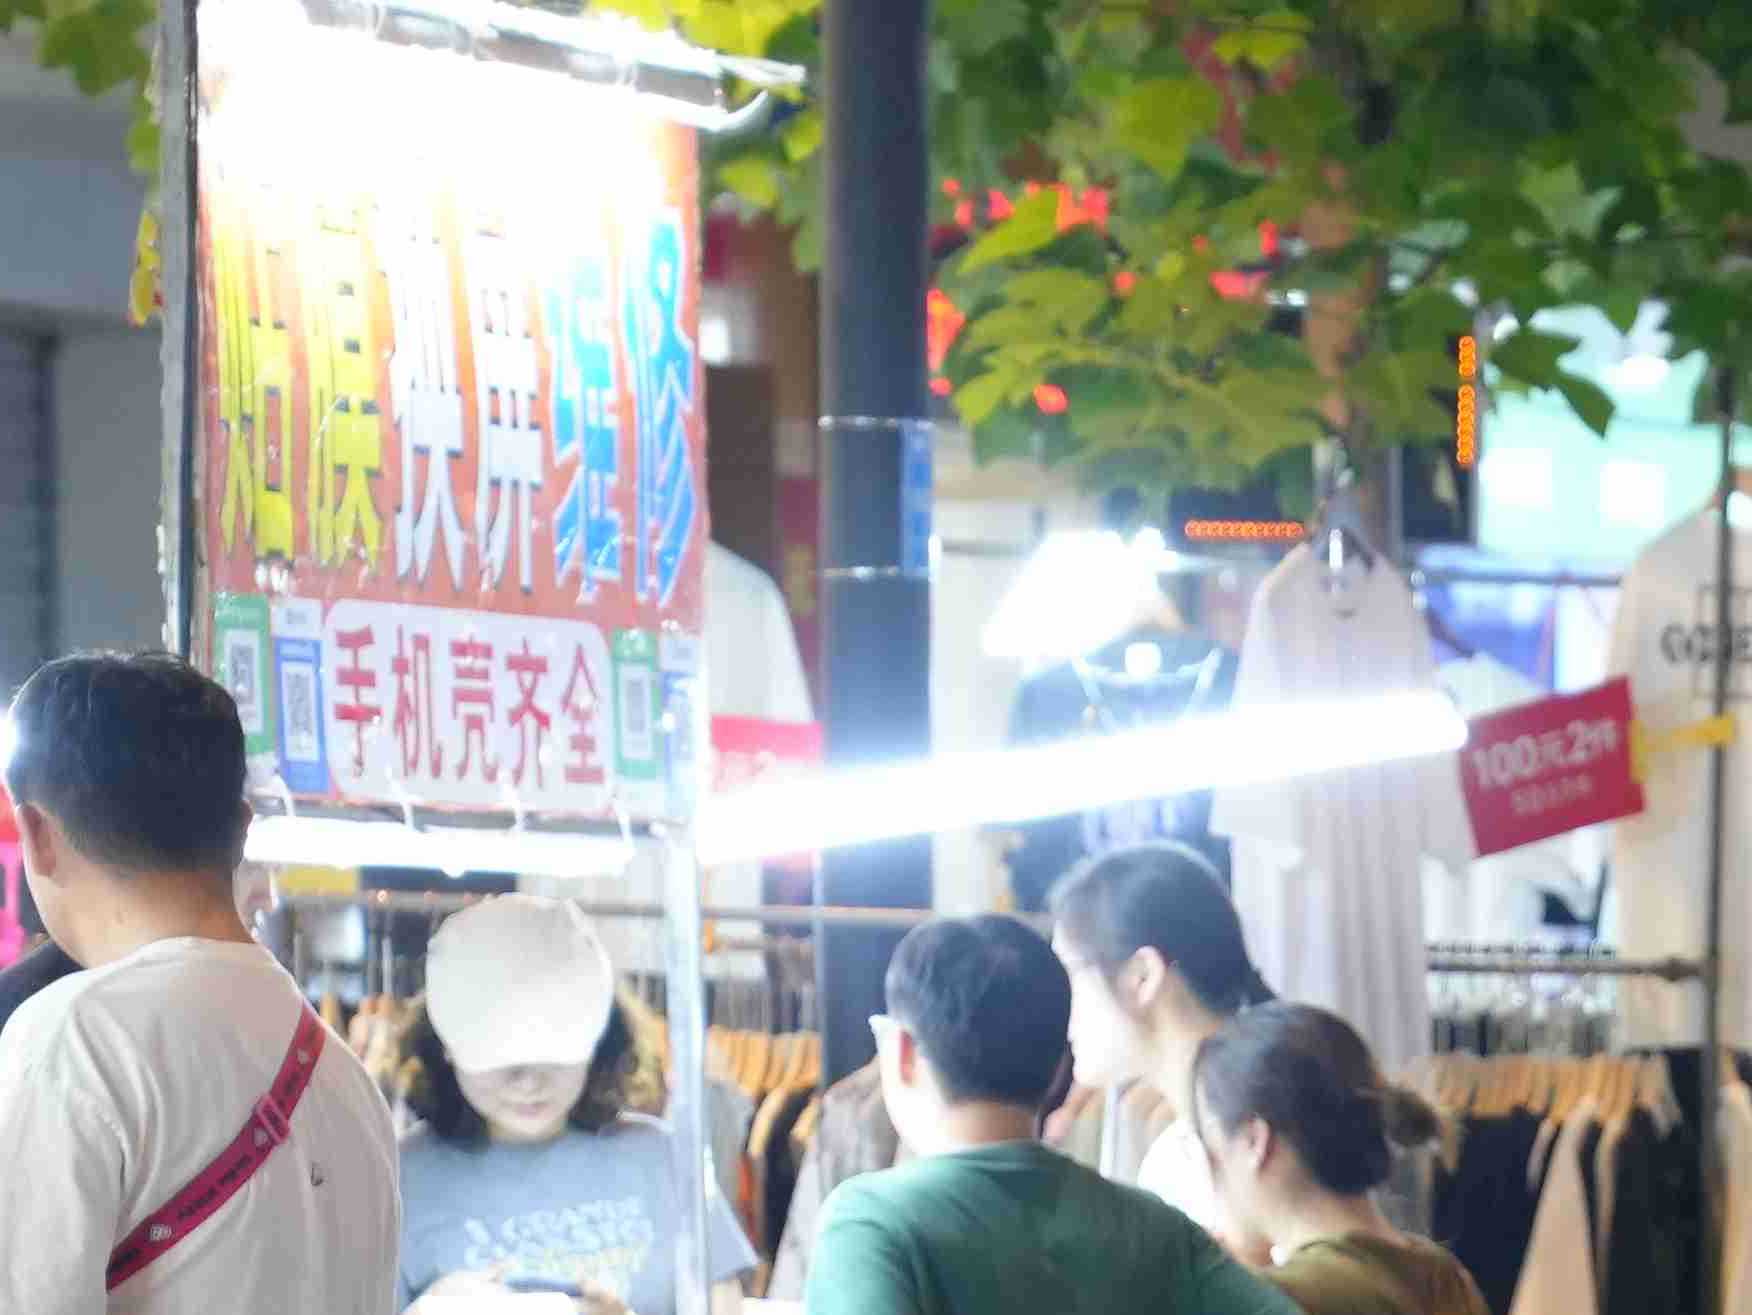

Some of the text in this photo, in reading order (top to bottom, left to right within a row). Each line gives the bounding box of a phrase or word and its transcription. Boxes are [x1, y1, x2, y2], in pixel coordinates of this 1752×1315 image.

[334, 622, 606, 790] 手机壳齐全
